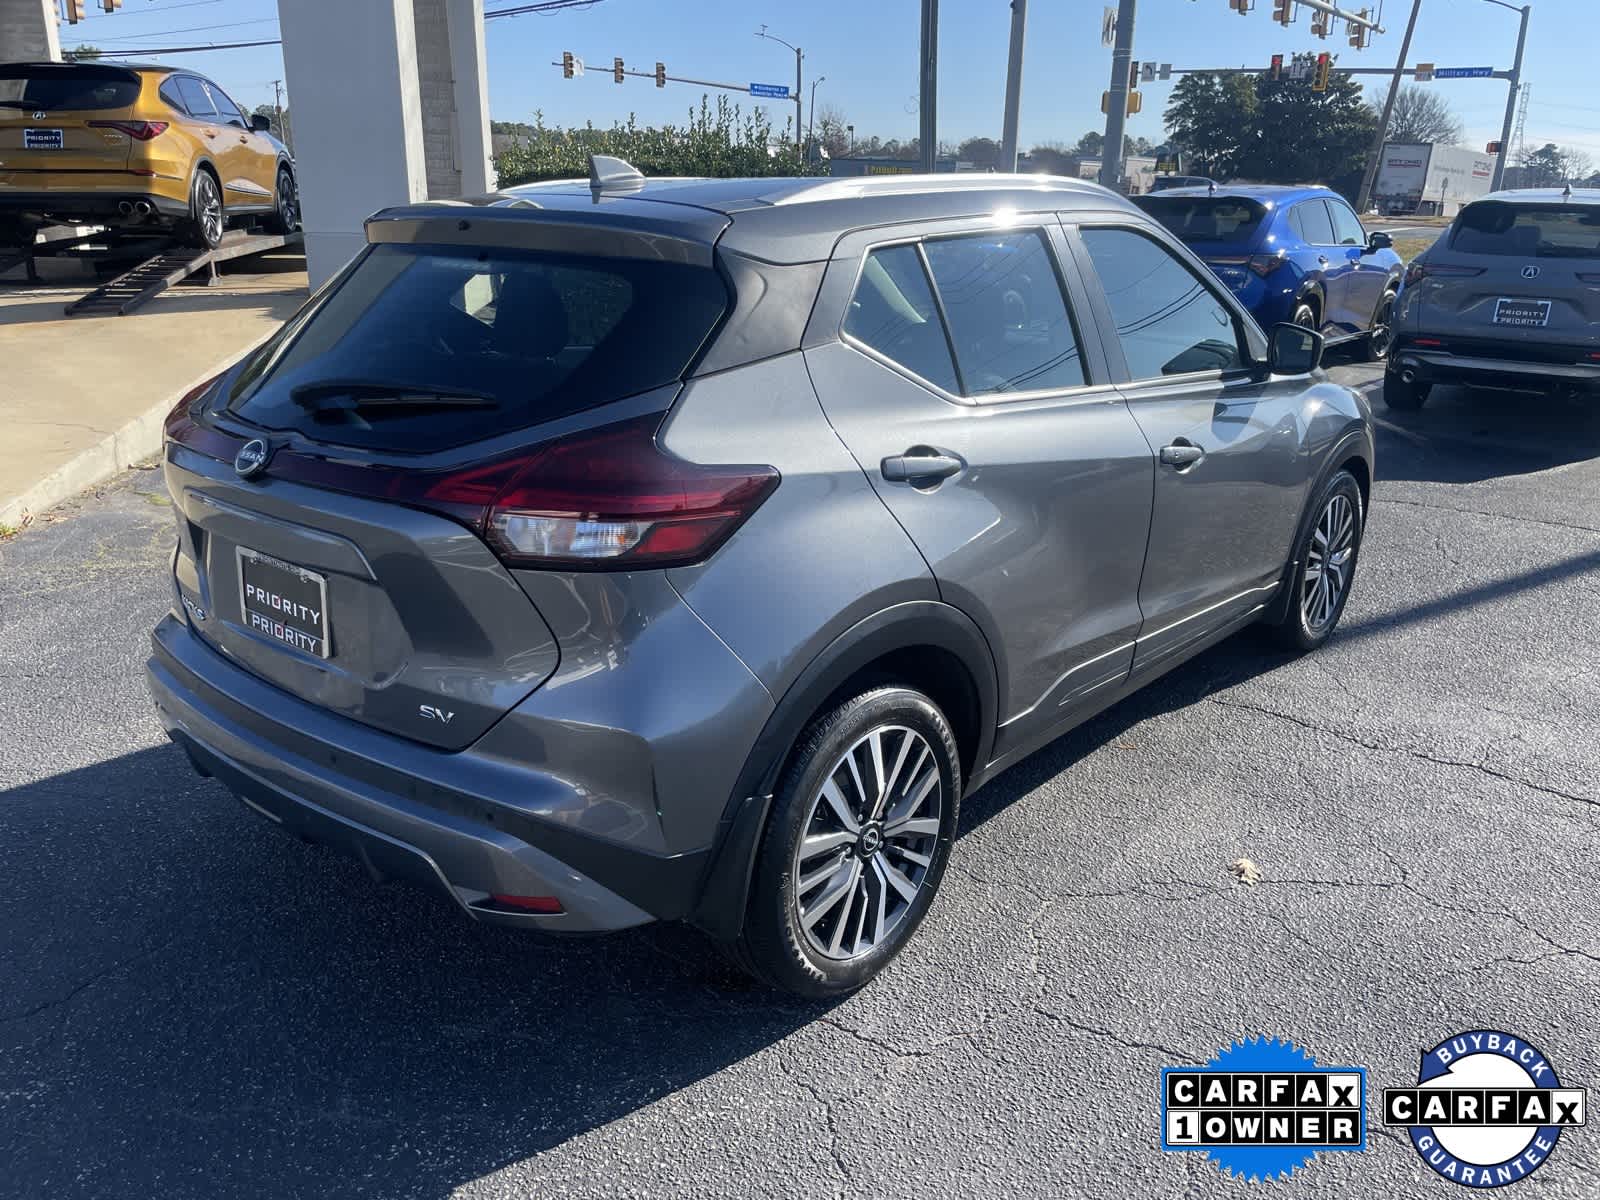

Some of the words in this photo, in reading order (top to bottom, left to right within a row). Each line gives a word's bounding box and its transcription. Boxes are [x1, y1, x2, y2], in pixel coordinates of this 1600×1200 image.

[1498, 309, 1545, 317] PRIORITY
[246, 583, 321, 625] PRIORITY
[251, 613, 317, 653] PRIORITY
[420, 704, 455, 724] SV
